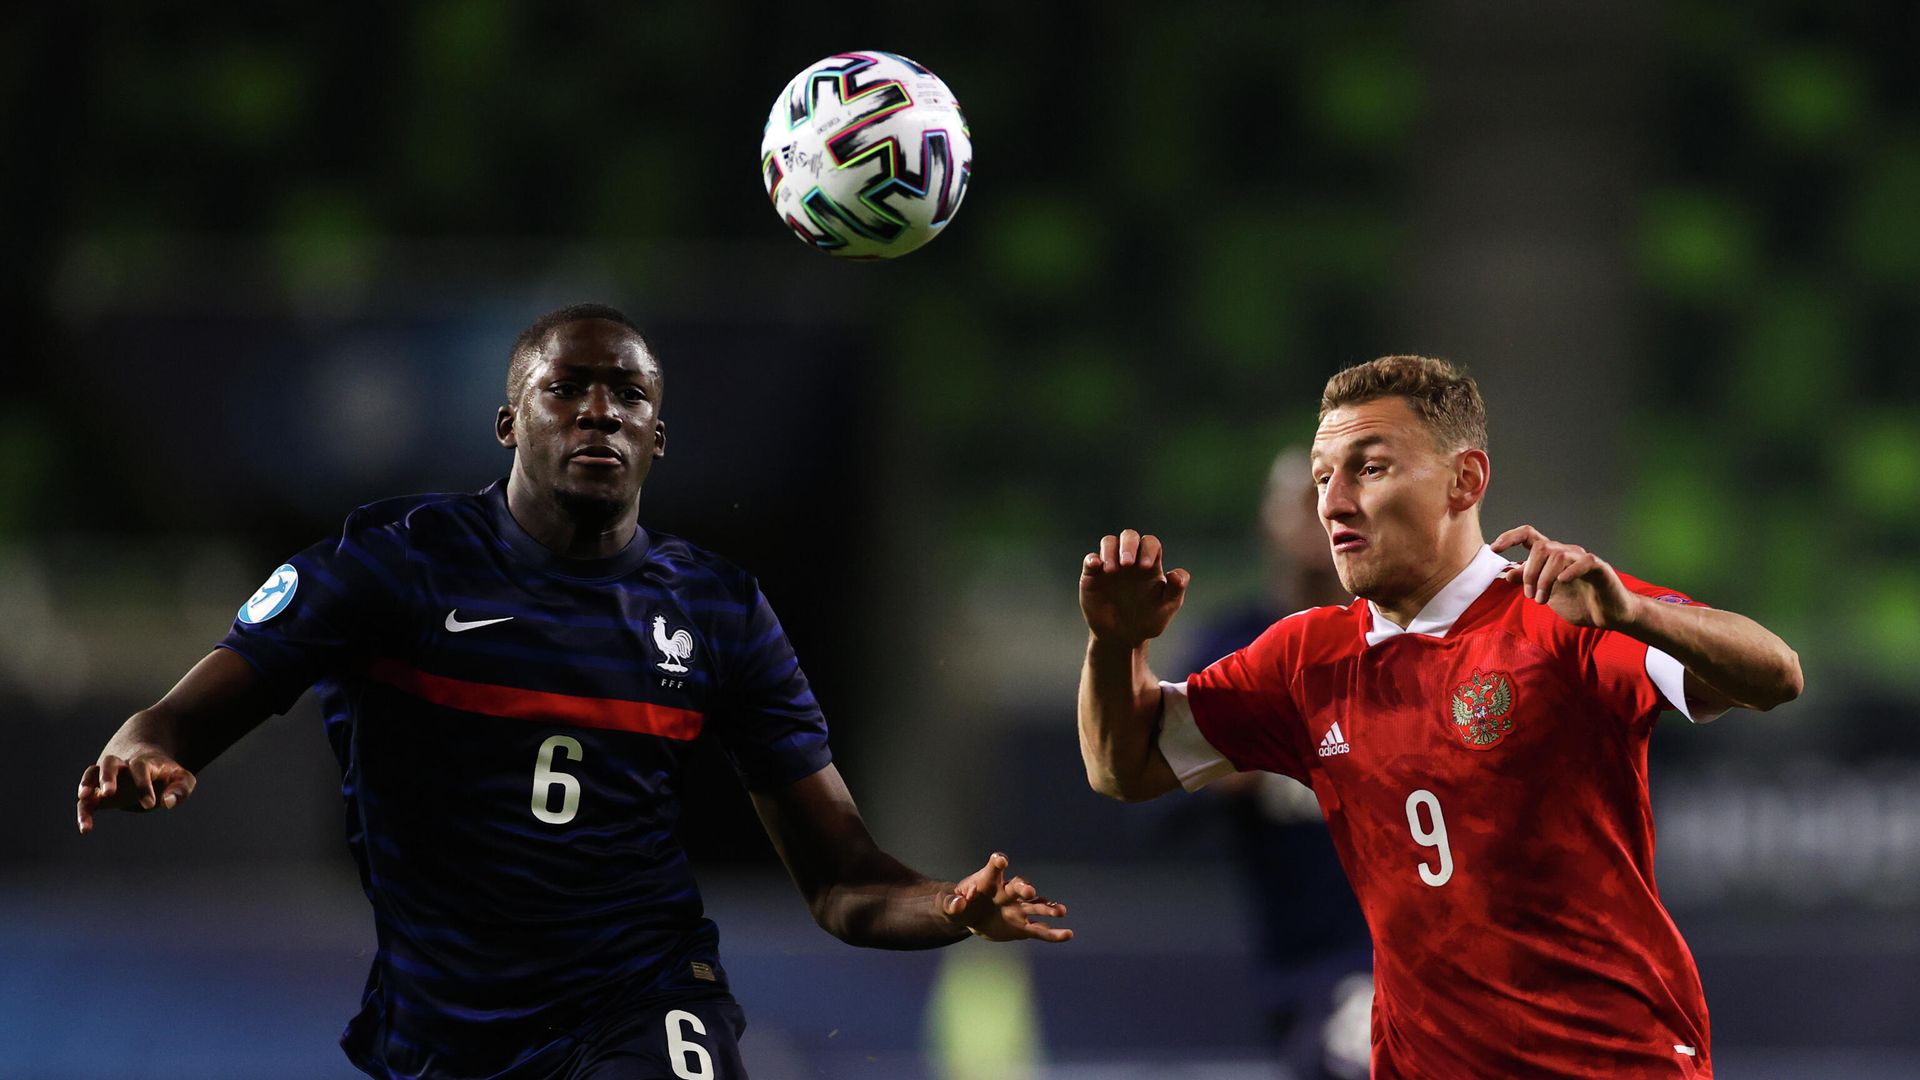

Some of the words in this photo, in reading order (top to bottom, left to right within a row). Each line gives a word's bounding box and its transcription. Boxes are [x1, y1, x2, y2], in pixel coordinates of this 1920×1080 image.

[531, 735, 581, 825] 6
[1318, 742, 1350, 757] adidas
[1405, 789, 1454, 887] 9
[664, 1009, 715, 1080] 6
